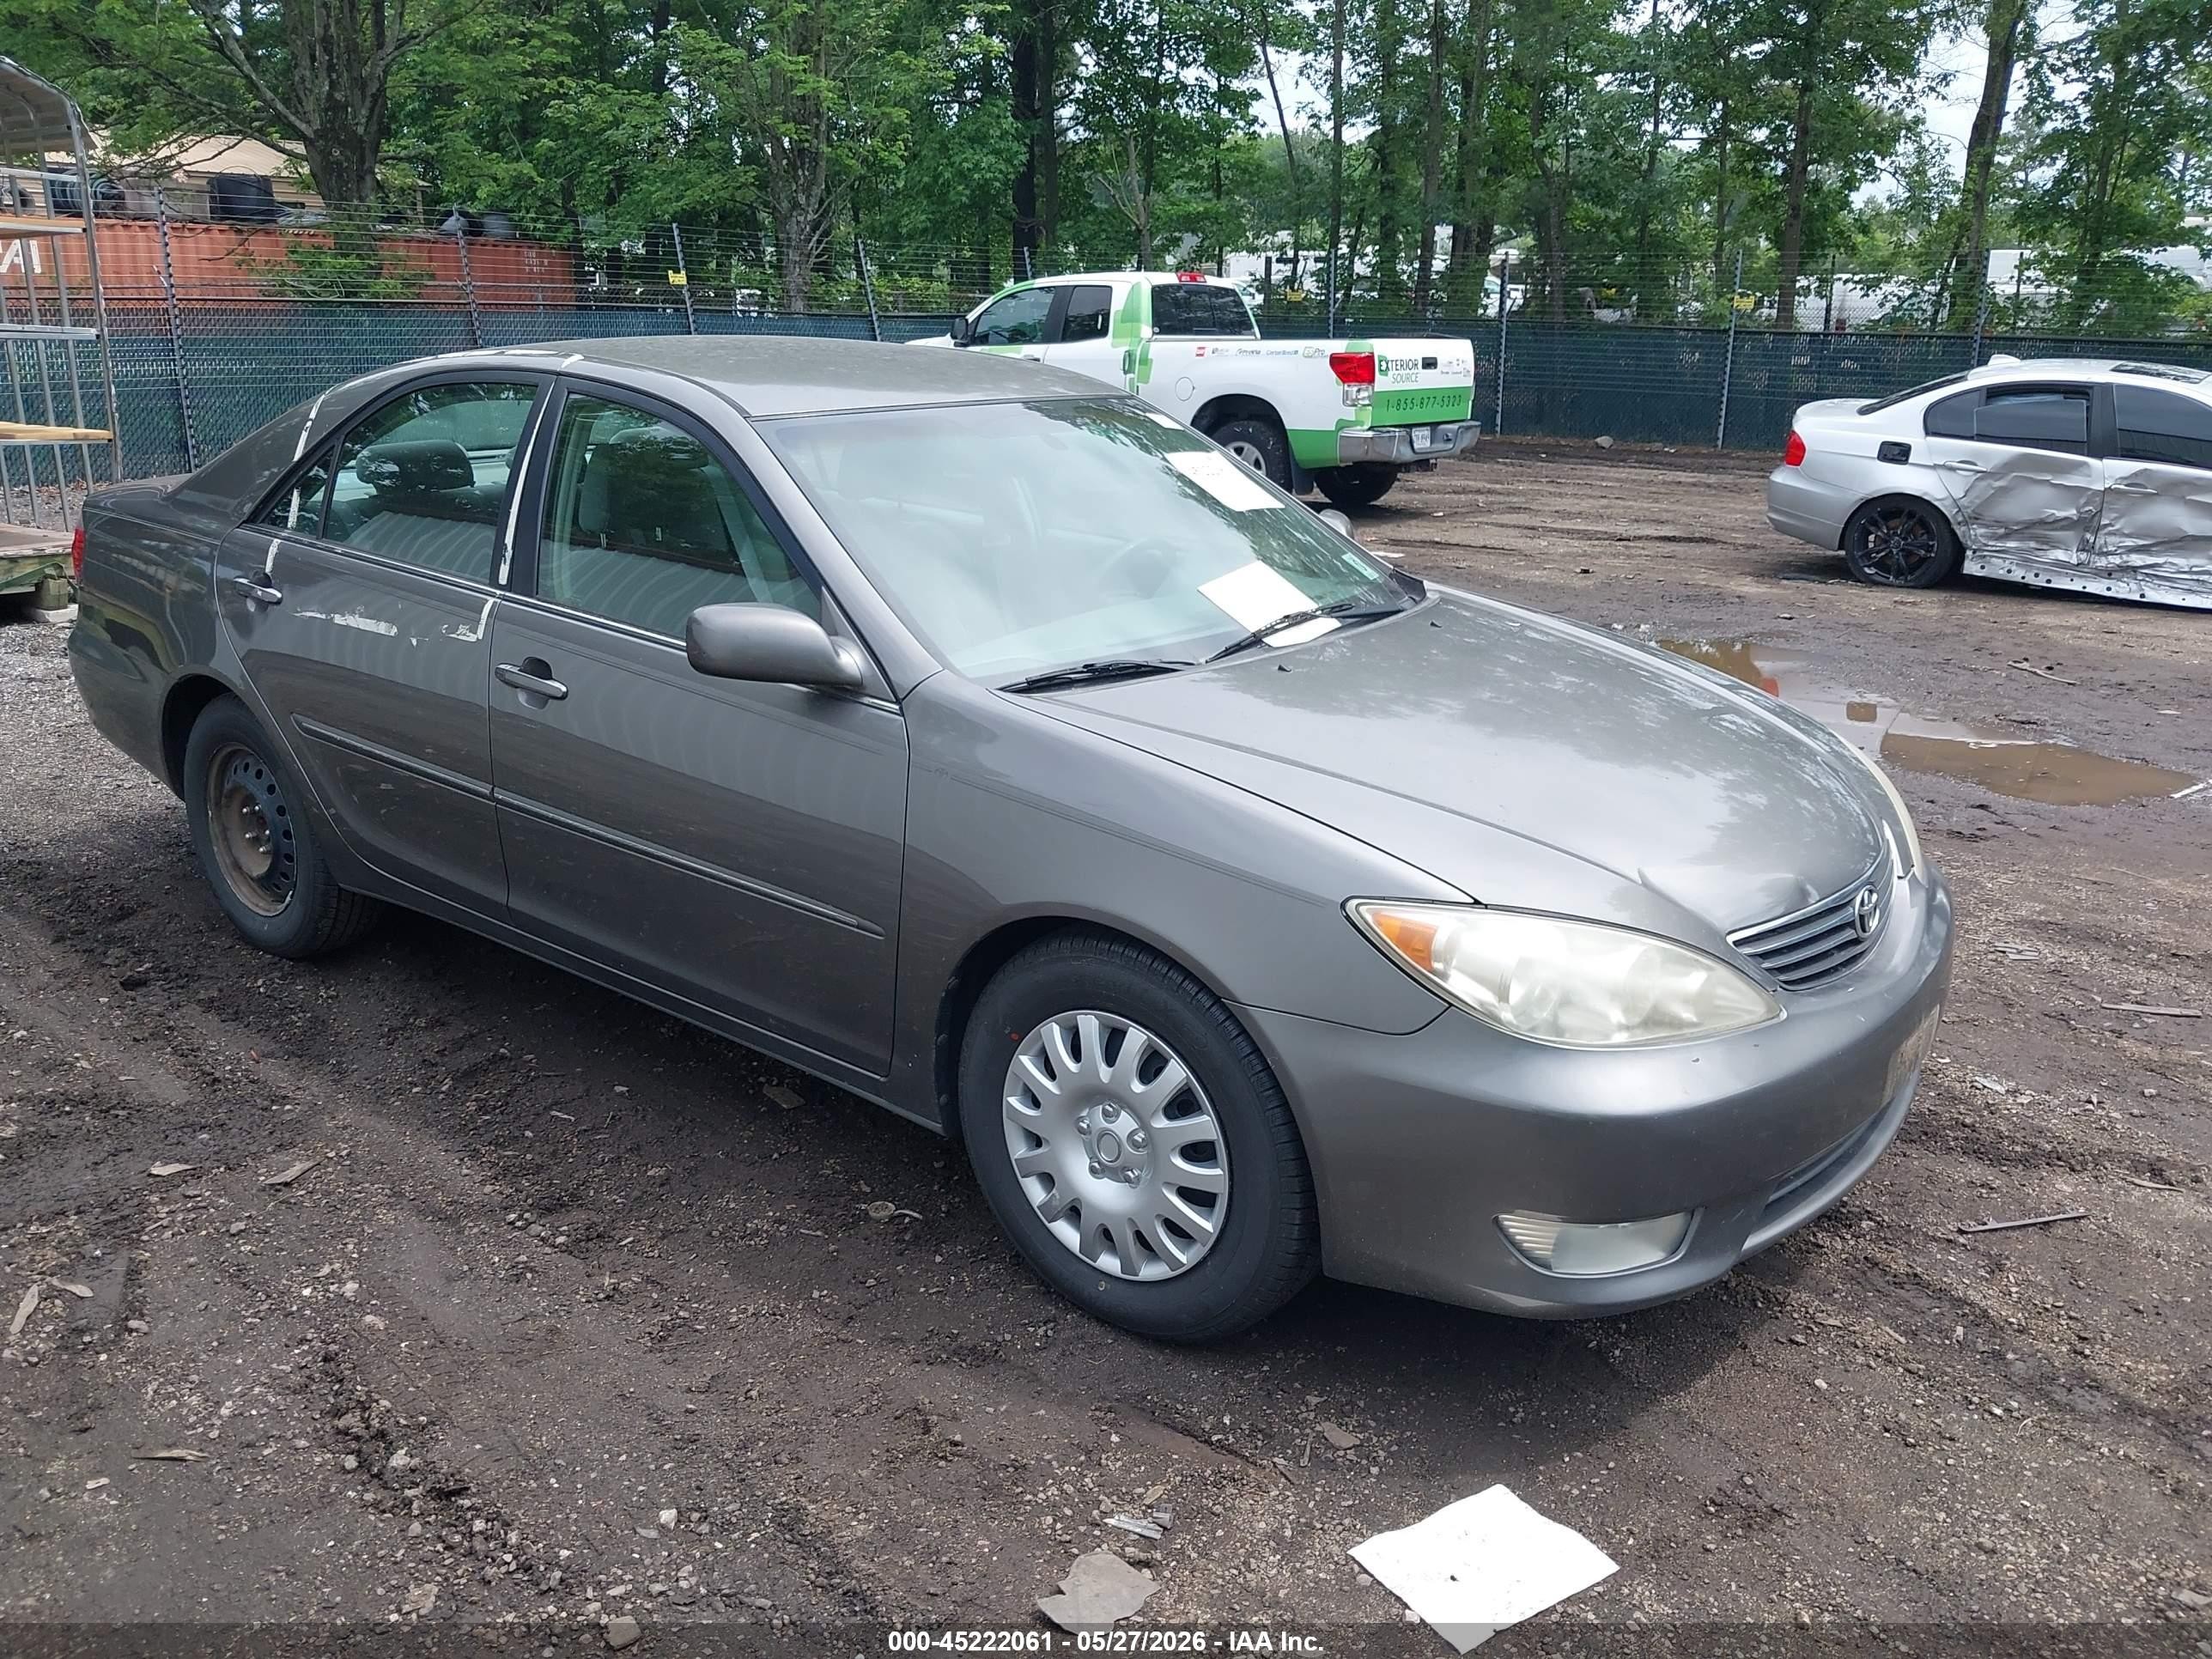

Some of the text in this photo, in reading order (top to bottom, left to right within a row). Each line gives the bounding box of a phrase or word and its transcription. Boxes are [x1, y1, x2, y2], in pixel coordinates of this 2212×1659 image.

[0, 239, 41, 273] AI
[1379, 358, 1419, 372] EXTERIOR
[1391, 372, 1419, 385] SOURCE
[1386, 394, 1462, 412] 1-855-877-5323
